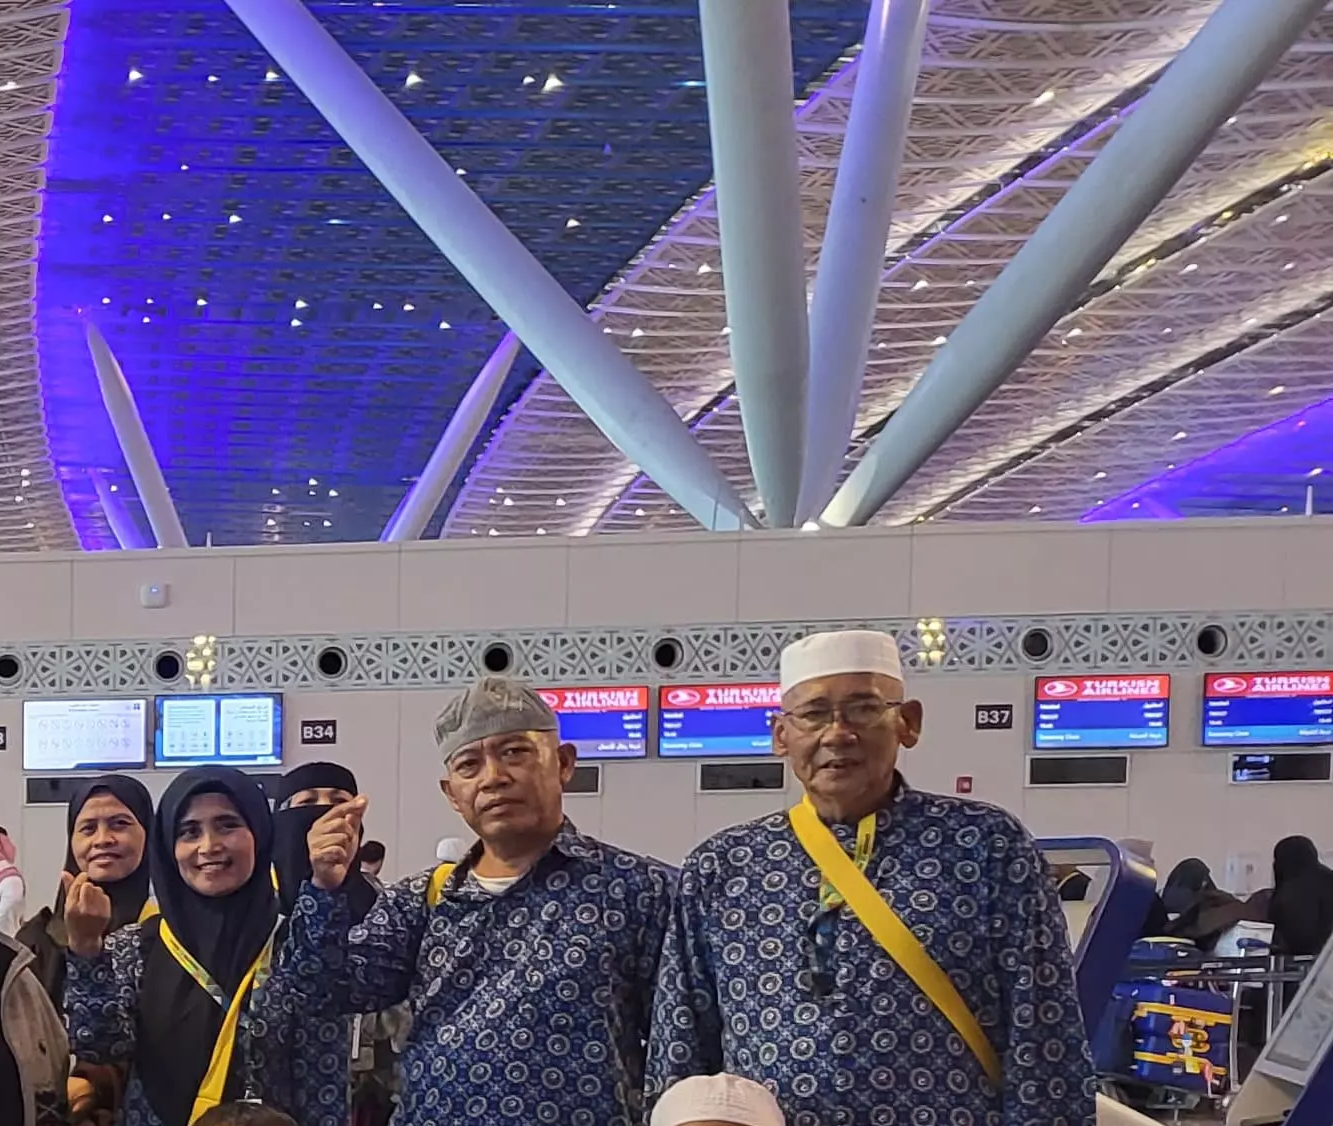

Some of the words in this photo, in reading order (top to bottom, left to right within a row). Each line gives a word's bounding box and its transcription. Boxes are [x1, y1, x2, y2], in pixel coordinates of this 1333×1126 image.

[1082, 680, 1160, 688] TURKISH
[1252, 676, 1330, 685] TURKISH
[1081, 687, 1161, 696] AIRLINES
[1251, 683, 1331, 692] AIRLINES
[977, 710, 1010, 724] B37
[303, 726, 333, 739] B34
